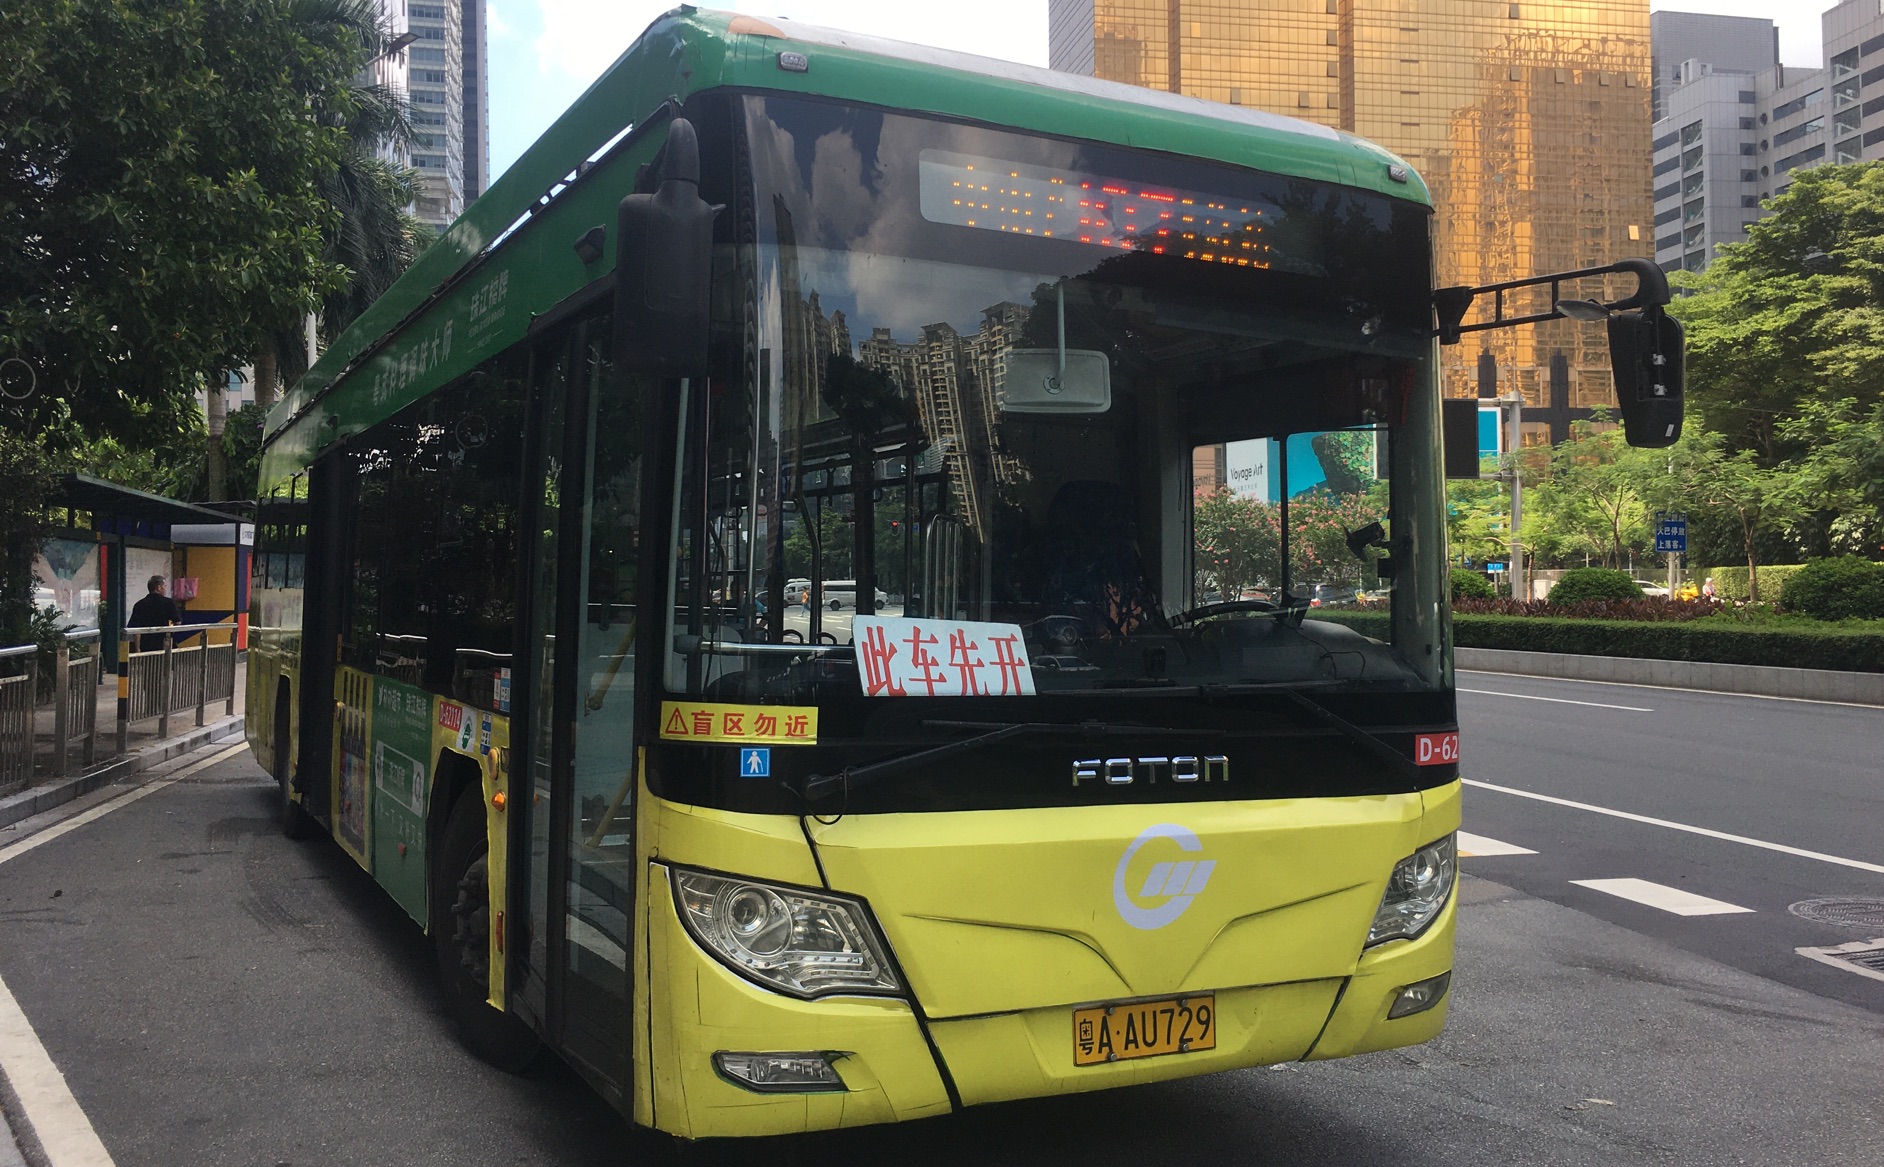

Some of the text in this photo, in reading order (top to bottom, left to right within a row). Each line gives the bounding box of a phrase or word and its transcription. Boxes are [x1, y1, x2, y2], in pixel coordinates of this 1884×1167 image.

[1231, 463, 1263, 481] Voyage Art
[862, 625, 1025, 696] 此车先开
[691, 710, 809, 738] 盲区勿近
[1072, 755, 1229, 786] FOTON
